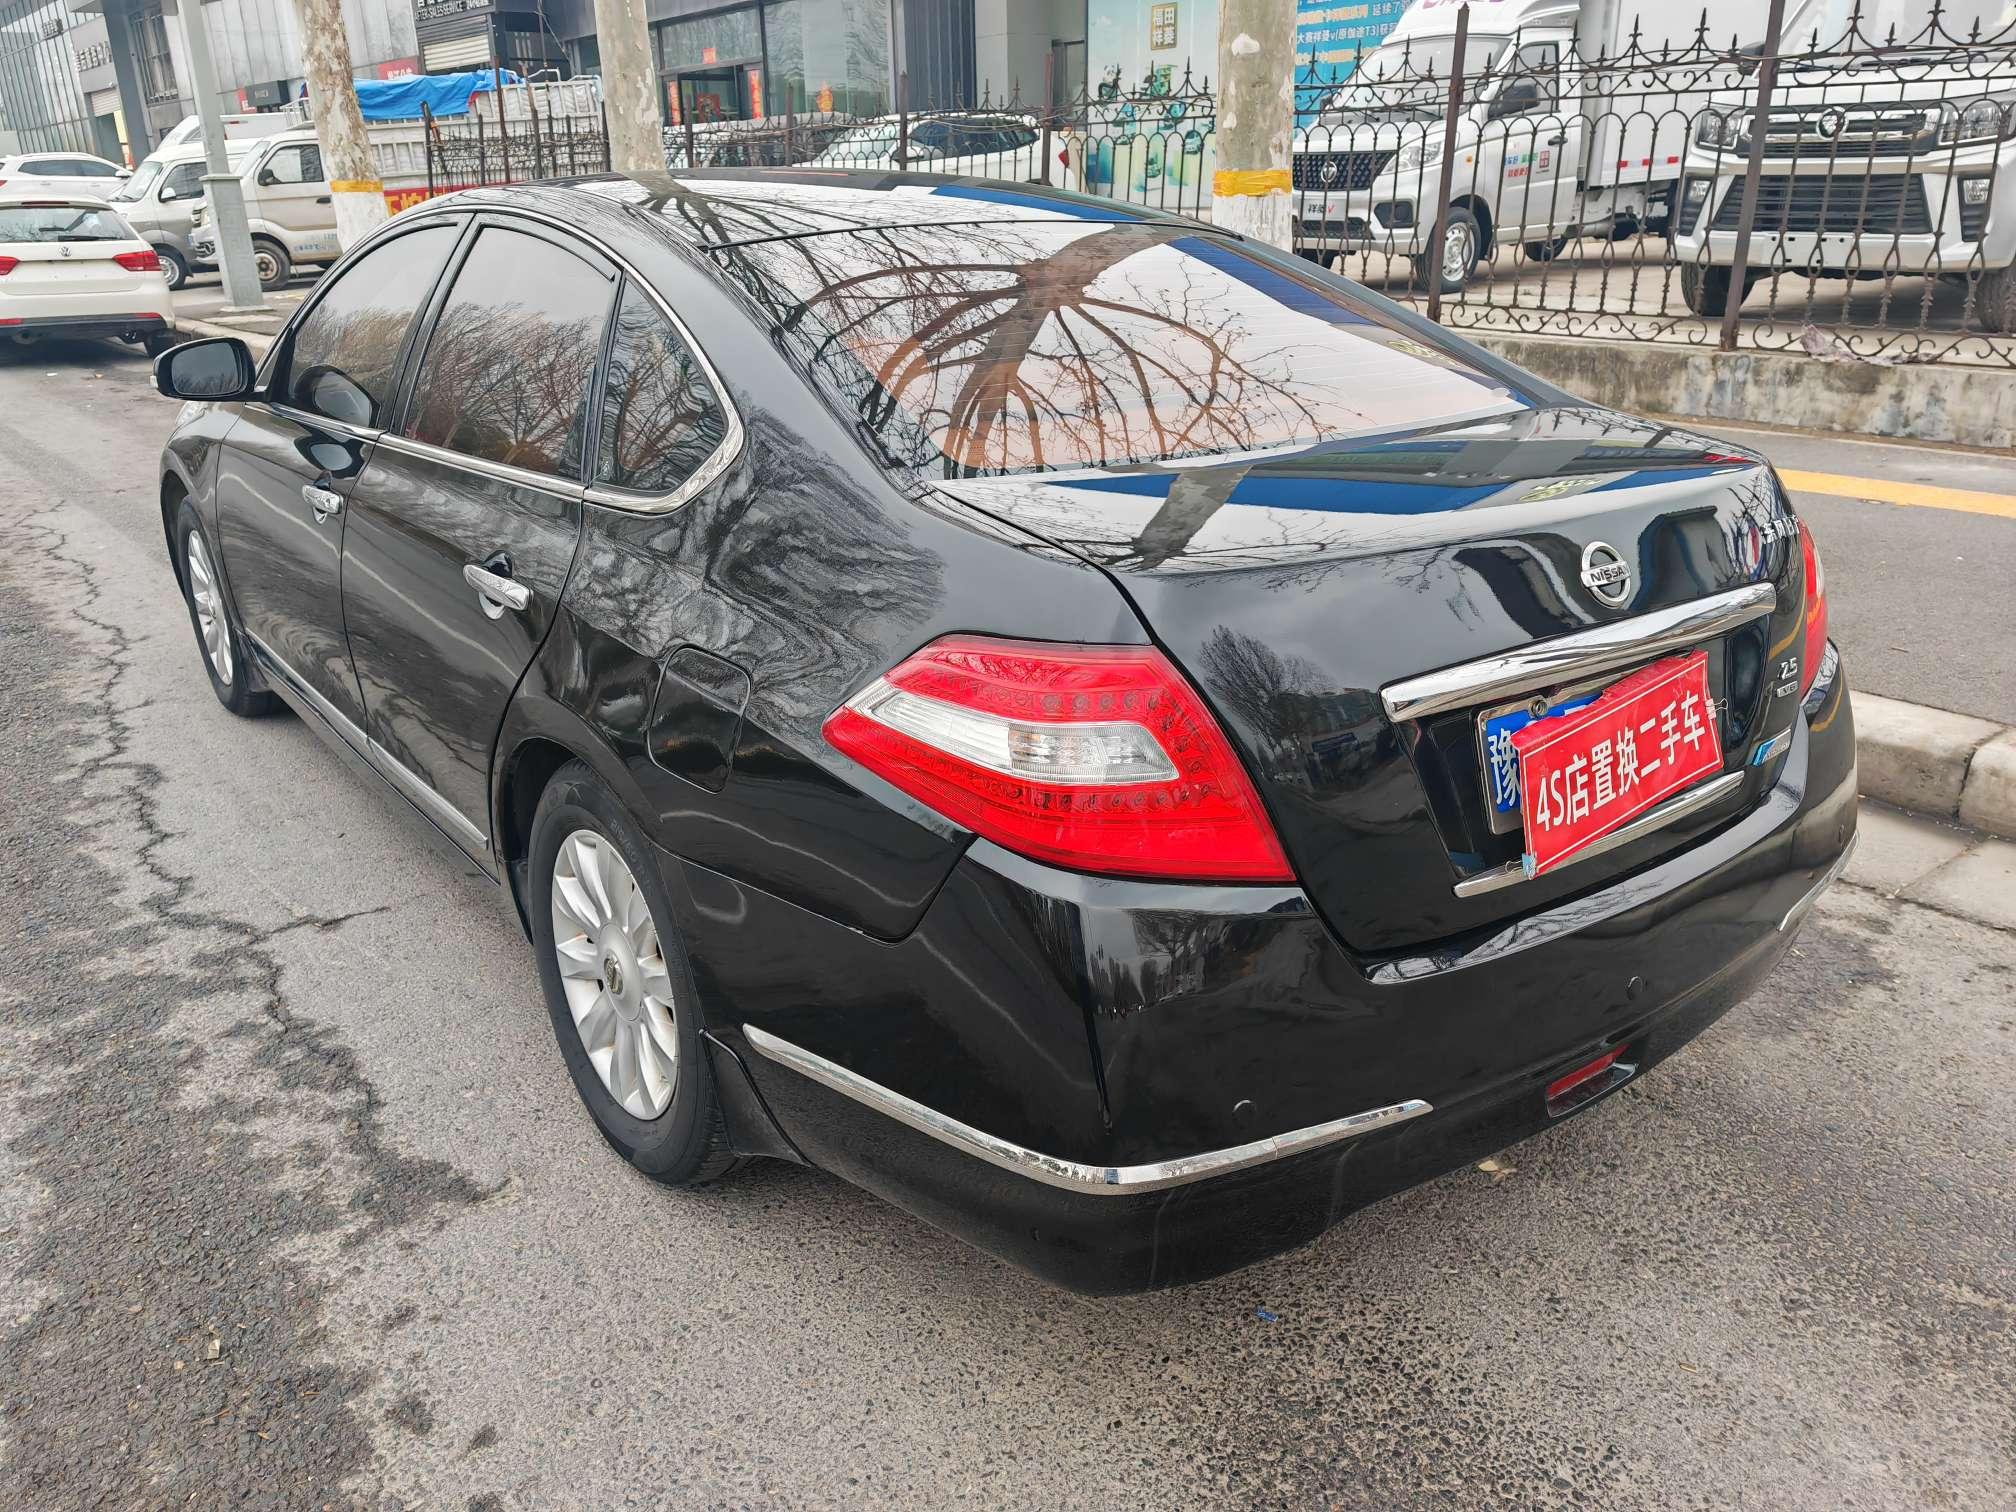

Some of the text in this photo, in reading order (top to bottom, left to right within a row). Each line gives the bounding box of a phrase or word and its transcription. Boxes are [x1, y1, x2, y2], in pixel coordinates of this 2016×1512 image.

[1536, 690, 1706, 832] 4S店置换二手车
